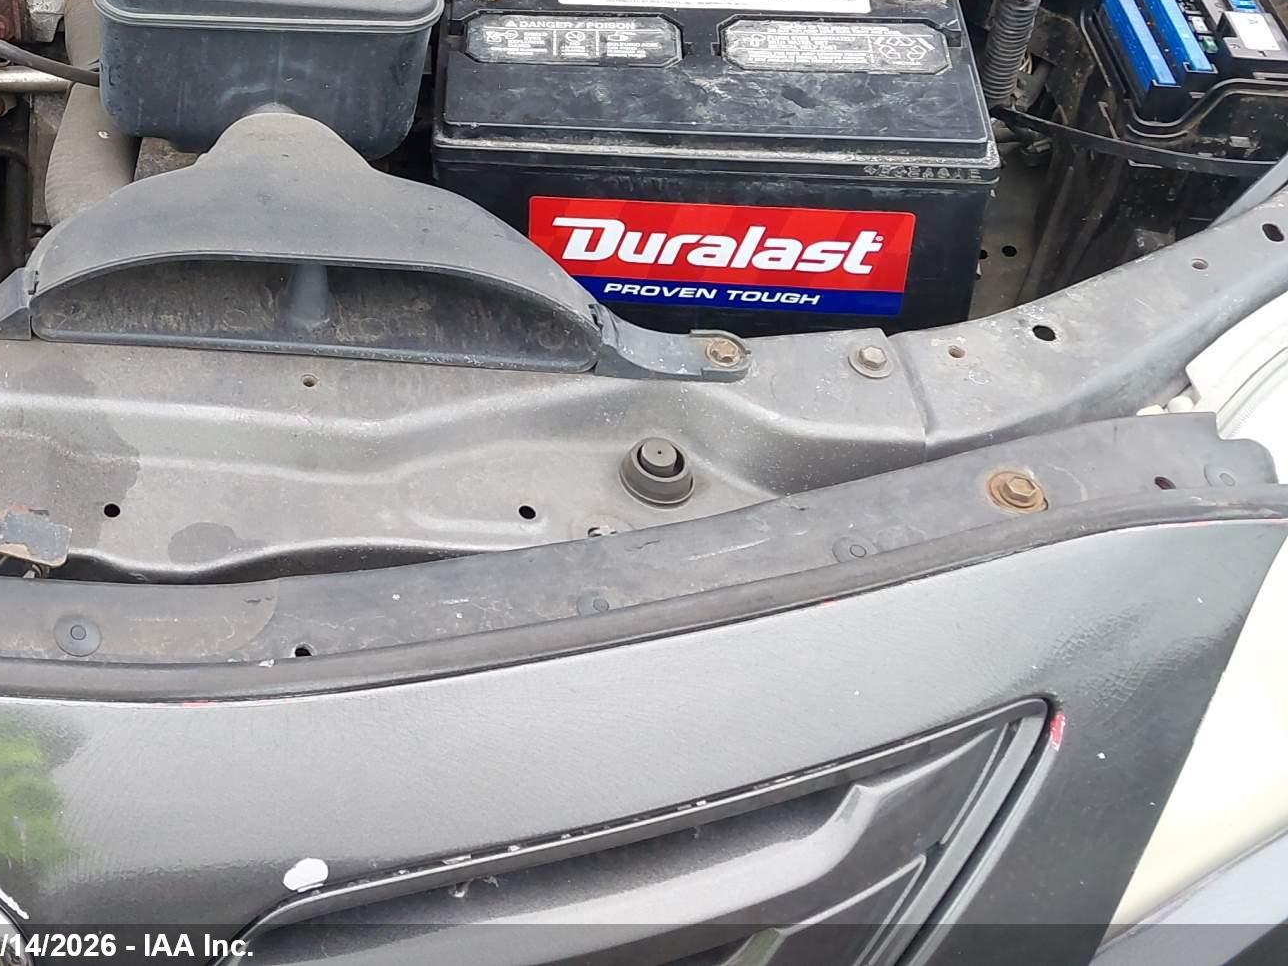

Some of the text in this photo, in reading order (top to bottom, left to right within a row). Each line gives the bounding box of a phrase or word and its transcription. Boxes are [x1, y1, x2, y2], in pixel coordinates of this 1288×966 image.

[519, 20, 573, 29] DANGER
[586, 21, 635, 30] POISON
[551, 216, 883, 275] Duralast
[603, 283, 821, 306] PROVEN TOUGH
